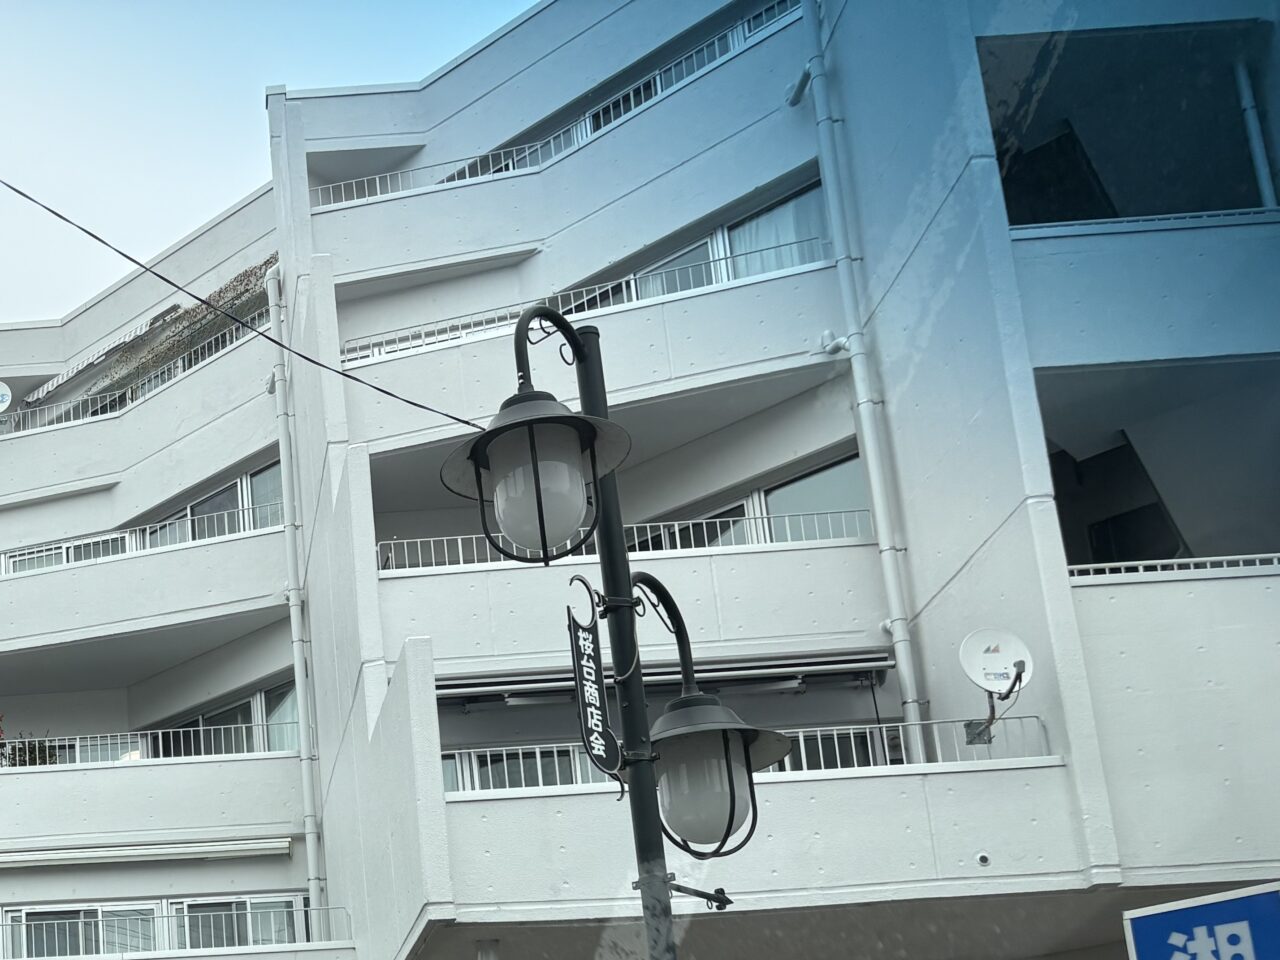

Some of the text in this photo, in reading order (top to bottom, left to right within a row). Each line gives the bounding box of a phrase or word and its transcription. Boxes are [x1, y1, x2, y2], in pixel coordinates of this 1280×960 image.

[577, 628, 606, 759] 桜台商店会
